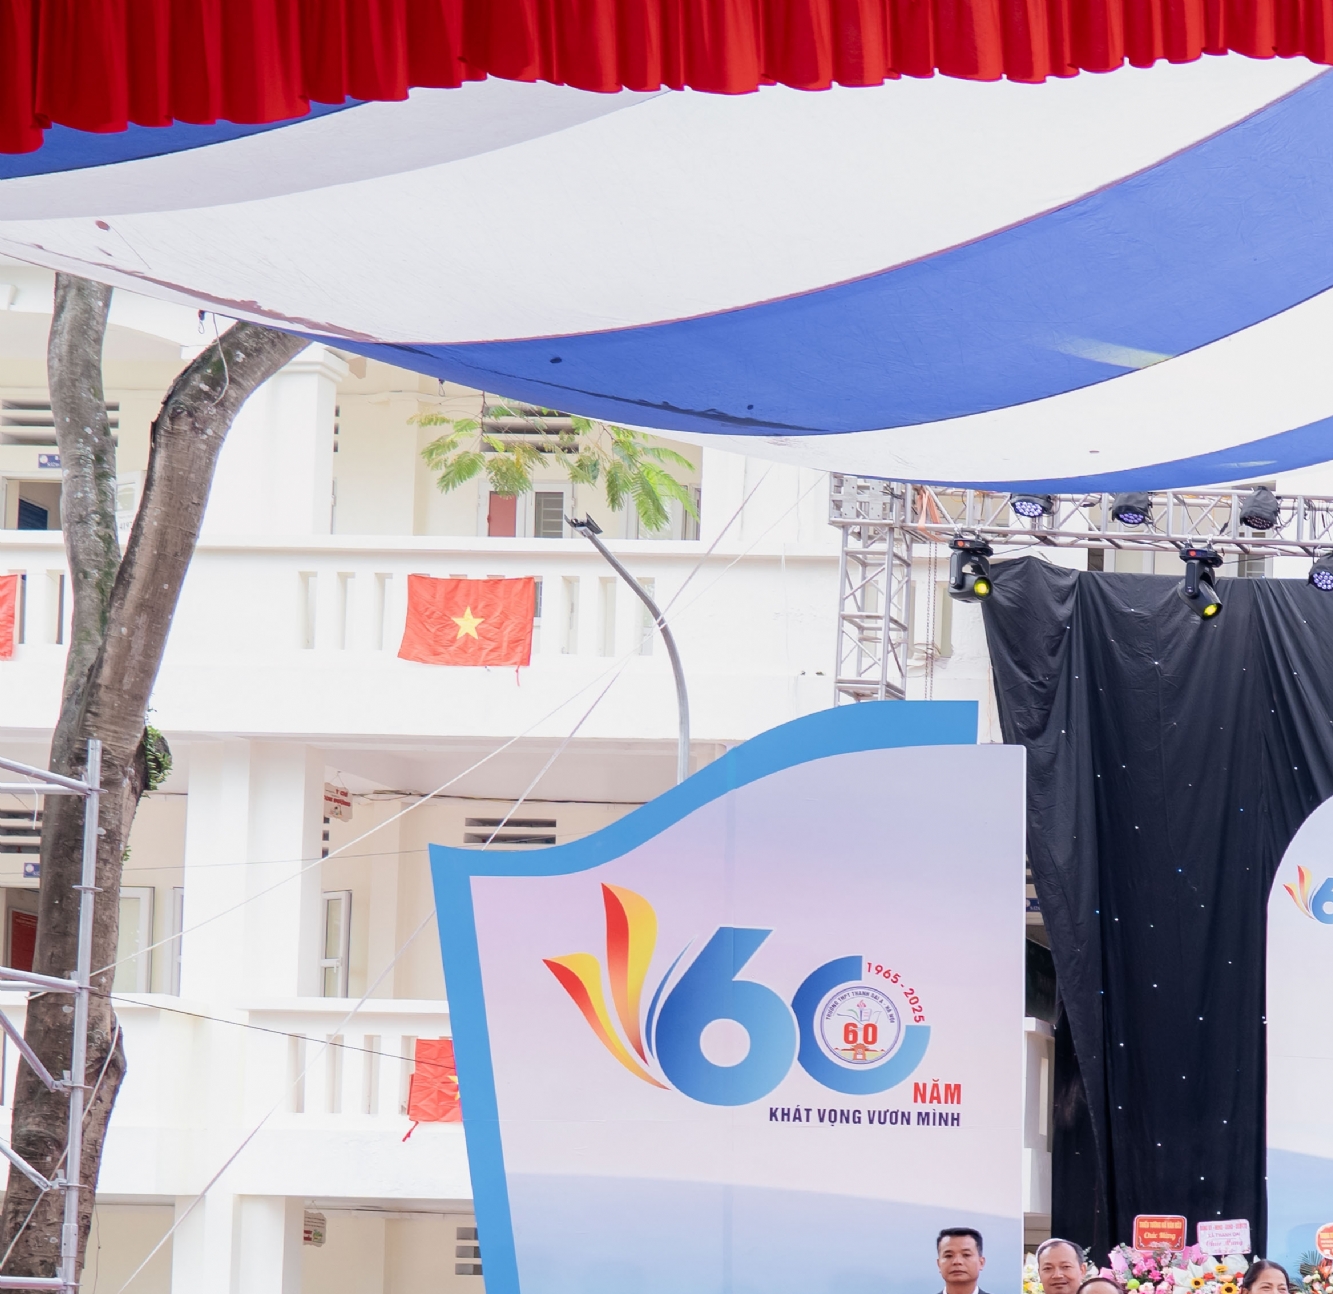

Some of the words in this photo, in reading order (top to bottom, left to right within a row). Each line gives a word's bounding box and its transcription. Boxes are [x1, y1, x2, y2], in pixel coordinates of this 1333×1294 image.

[655, 926, 931, 1106] 60
[844, 1022, 878, 1045] 60
[913, 1079, 962, 1105] NĂM
[769, 1104, 814, 1124] KHÁT
[817, 1108, 862, 1128] VỌNG
[867, 1107, 912, 1126] VƯƠN
[916, 1106, 961, 1127] MÌNH
